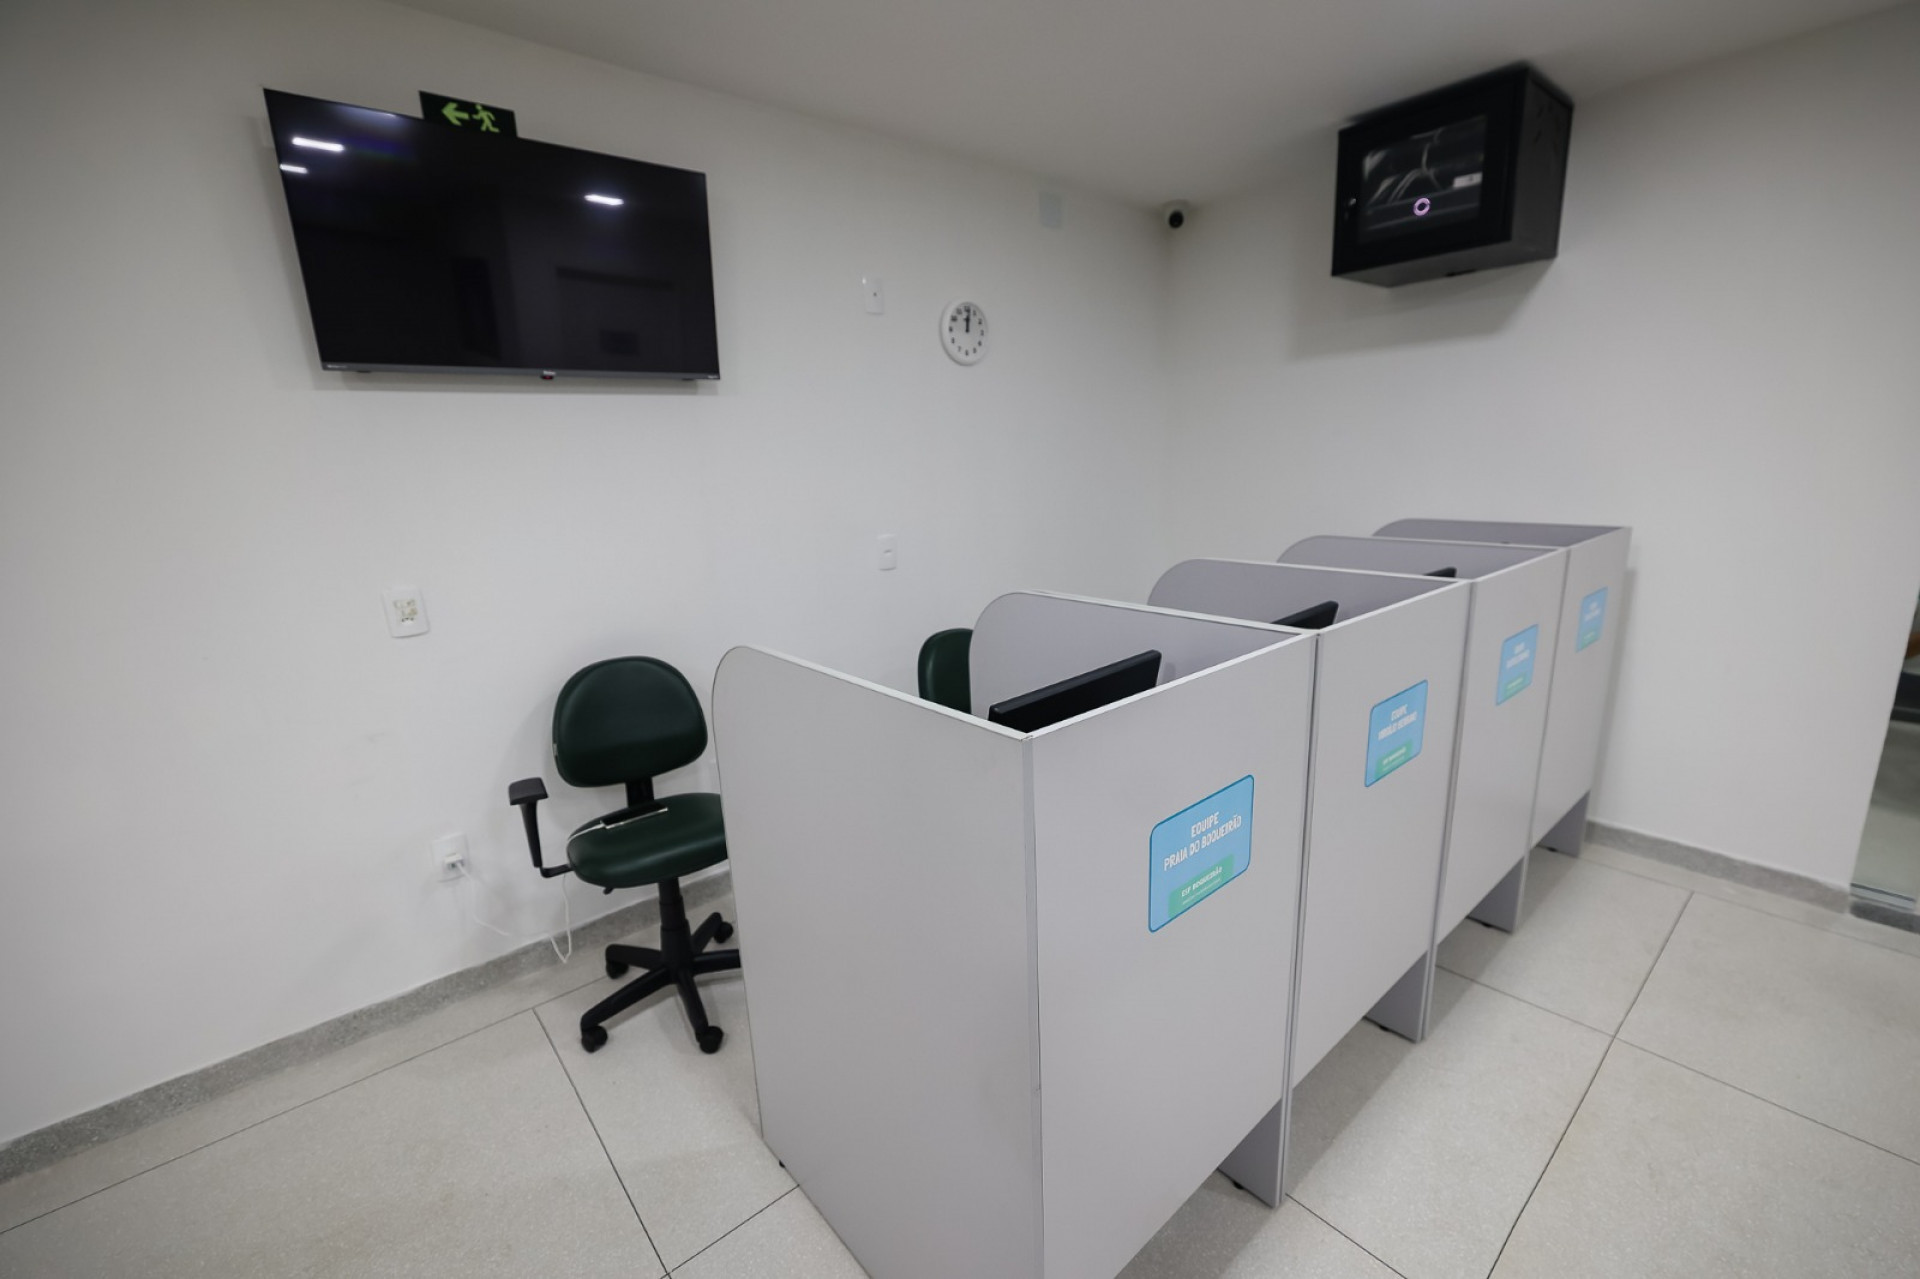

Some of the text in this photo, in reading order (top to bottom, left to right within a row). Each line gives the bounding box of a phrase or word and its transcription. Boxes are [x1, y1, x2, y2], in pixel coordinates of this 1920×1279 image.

[1164, 813, 1242, 871] PRAIA DO BOQUEIRÃO
[1191, 811, 1220, 837] EQUIPE
